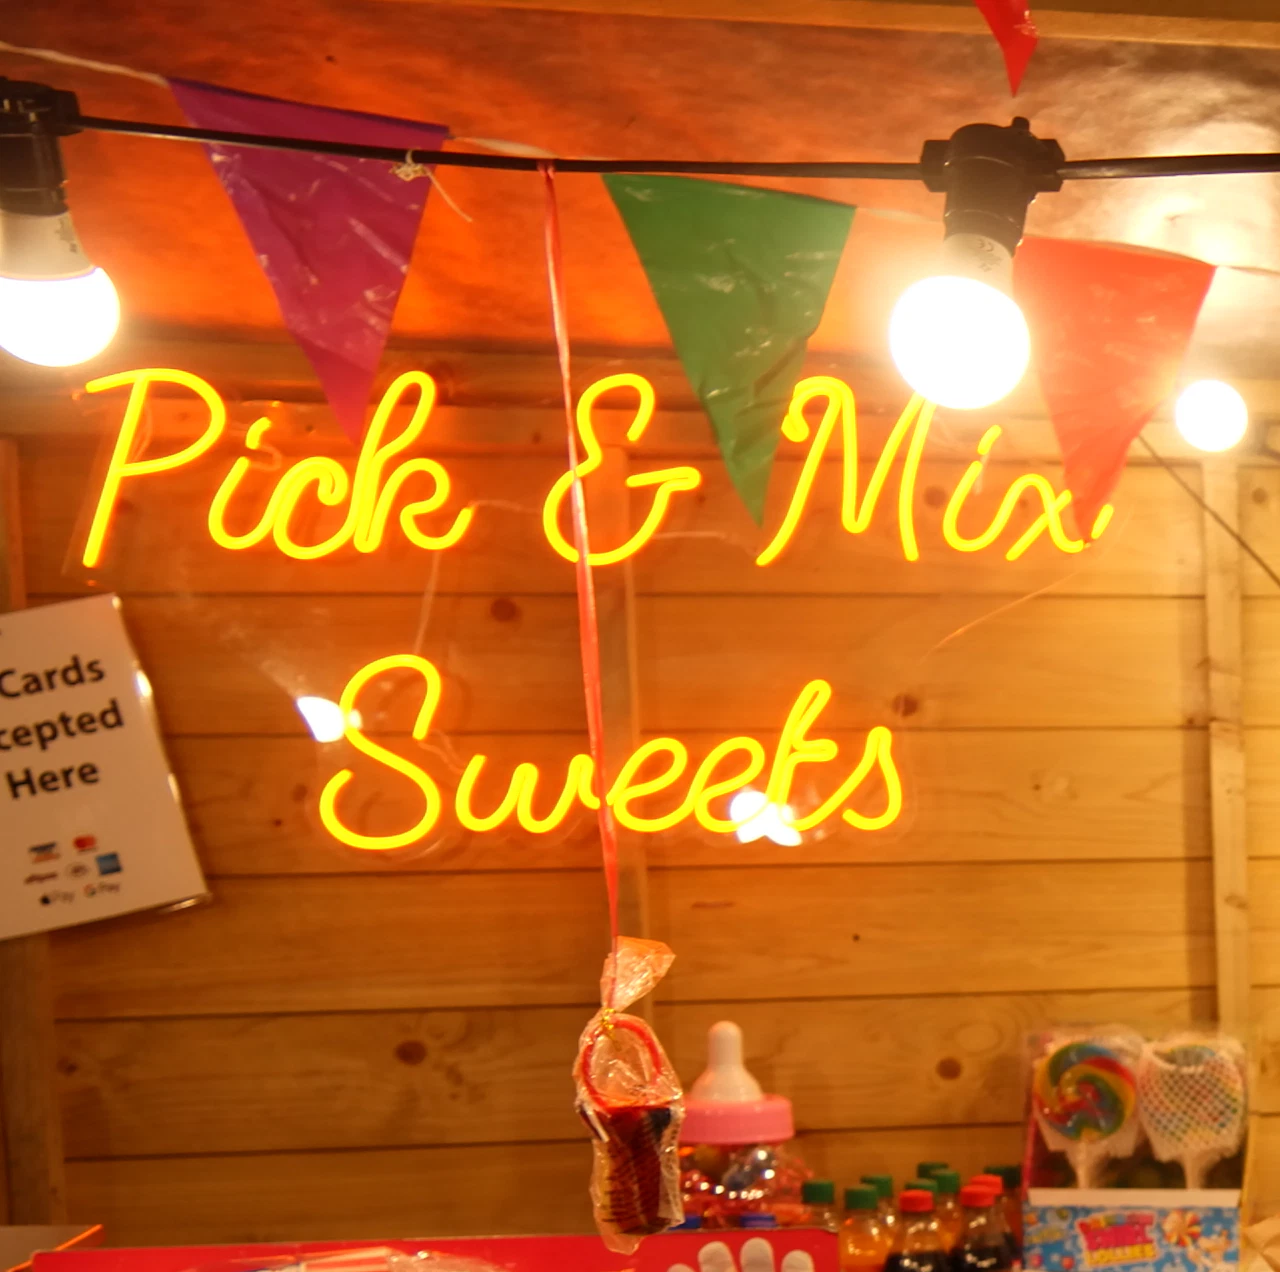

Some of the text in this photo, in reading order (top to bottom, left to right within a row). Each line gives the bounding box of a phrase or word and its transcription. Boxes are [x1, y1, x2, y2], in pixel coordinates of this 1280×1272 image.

[83, 367, 1118, 568] Pick & Mix
[0, 655, 105, 698] Cards
[5, 762, 100, 799] Here
[319, 654, 903, 850] Sweets
